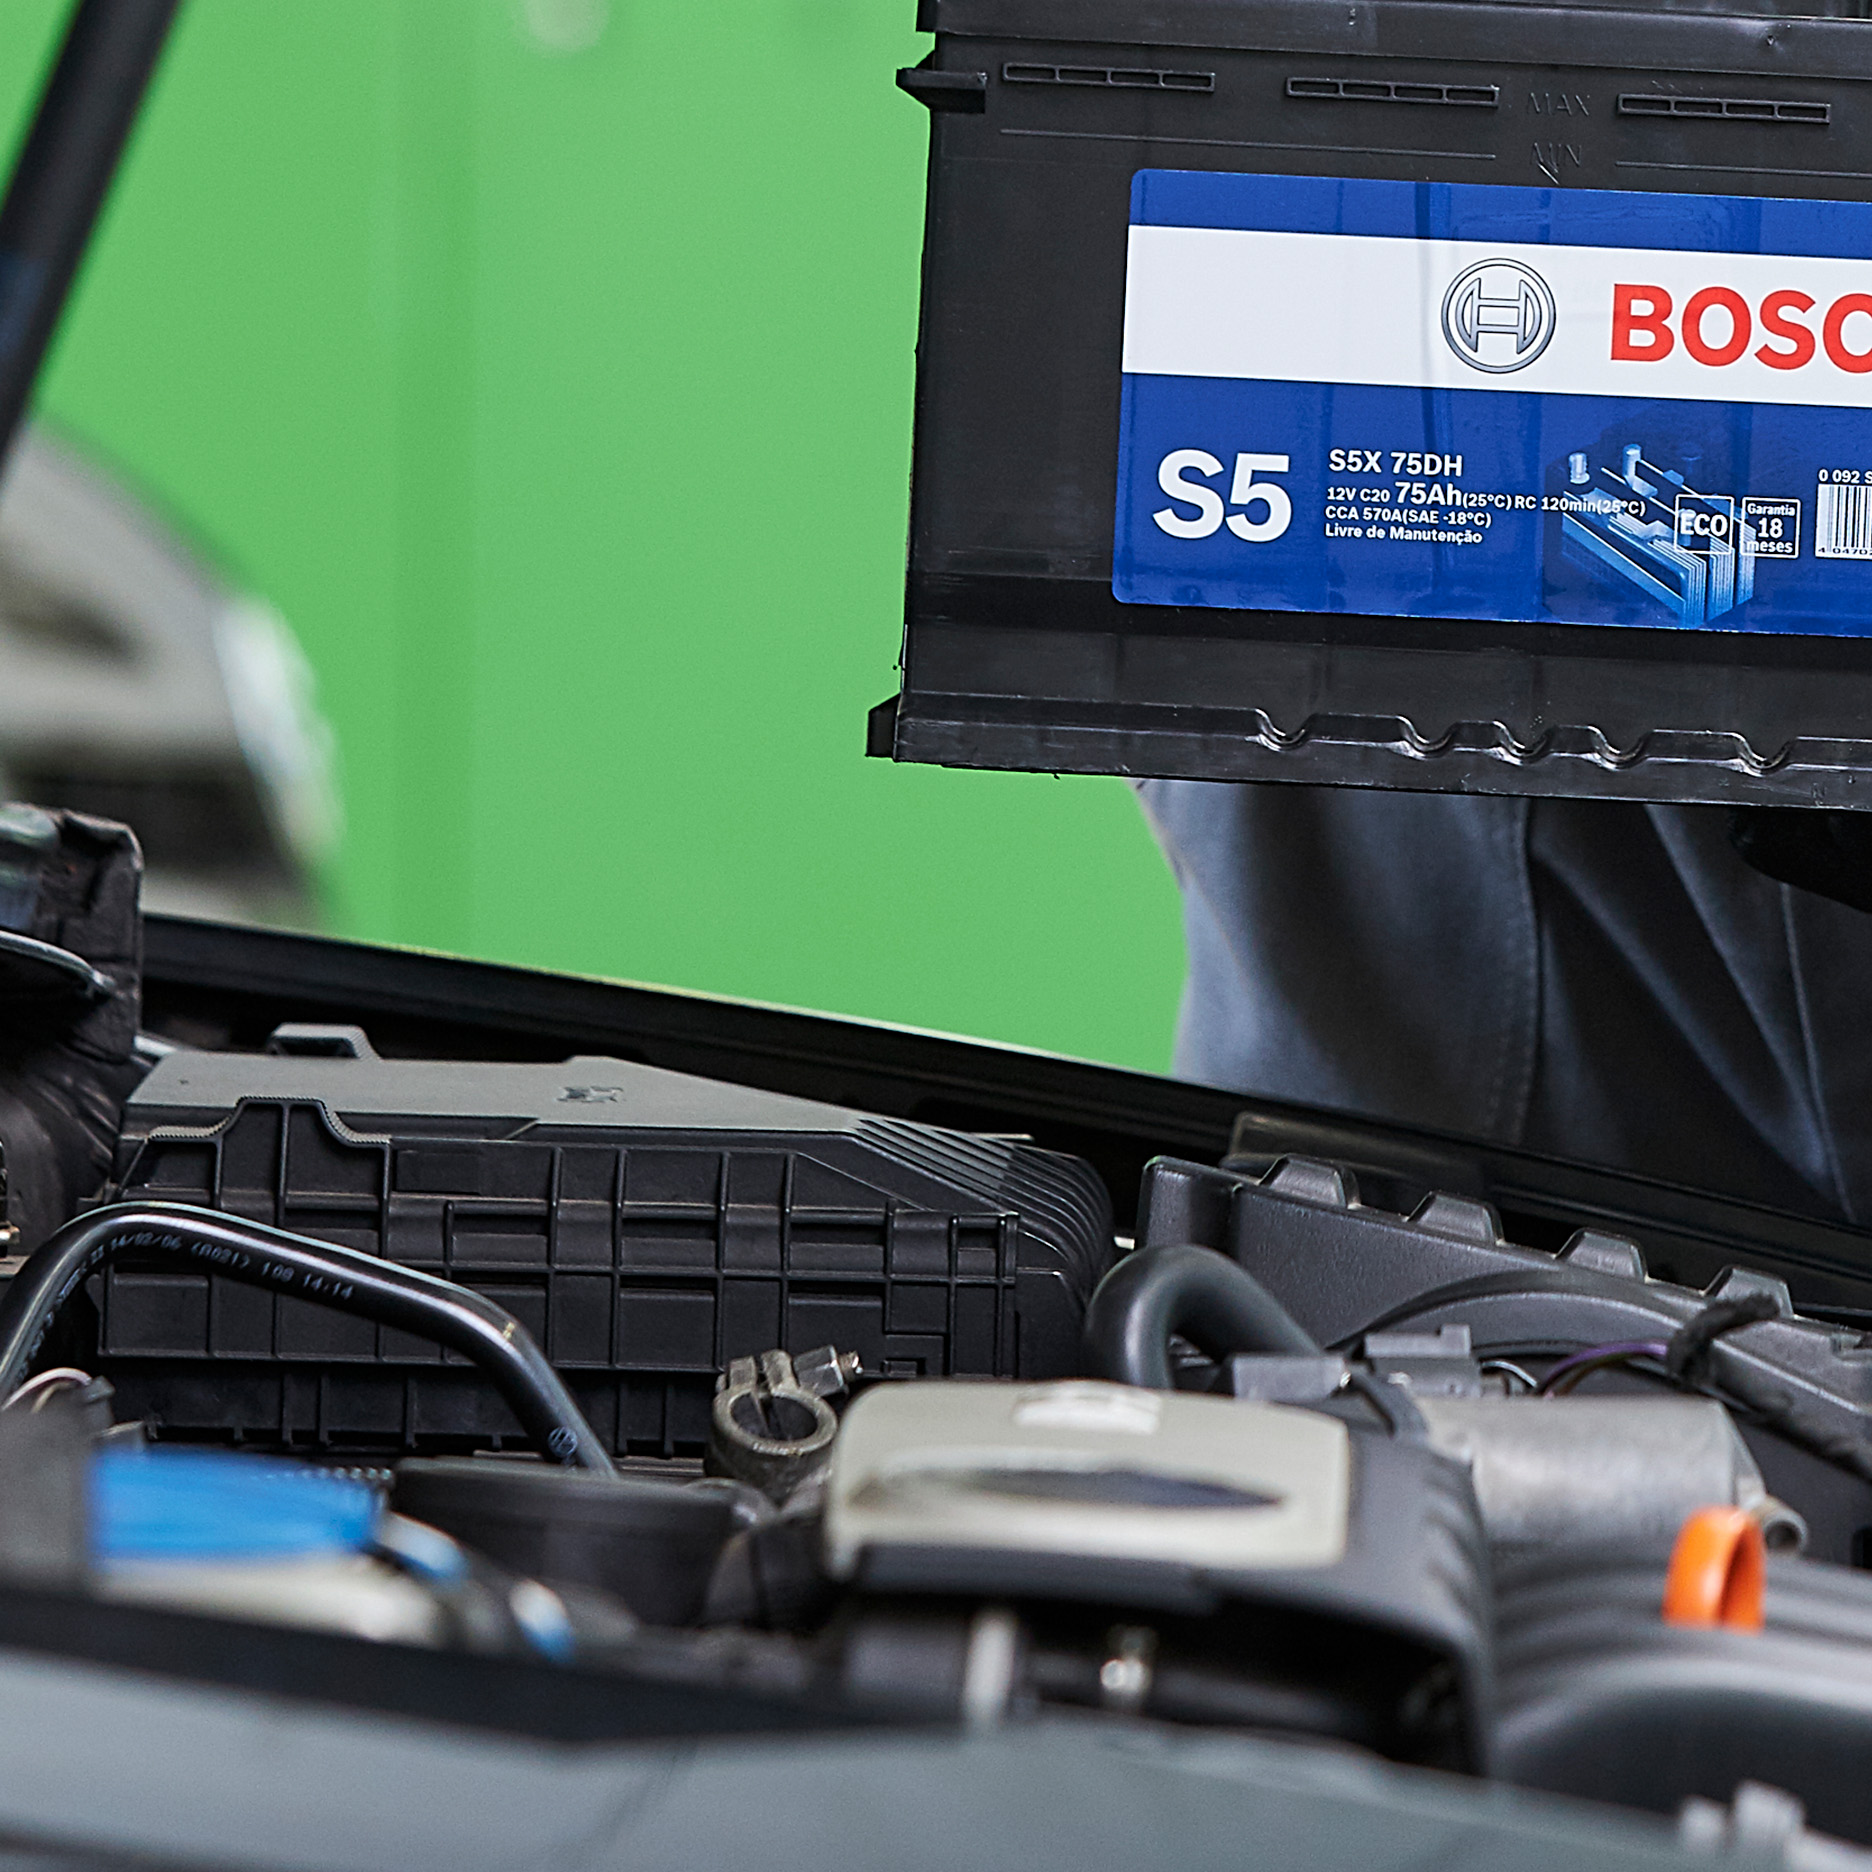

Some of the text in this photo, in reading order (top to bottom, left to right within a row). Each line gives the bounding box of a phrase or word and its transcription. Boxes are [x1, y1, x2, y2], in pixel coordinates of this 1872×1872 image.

[1328, 448, 1463, 477] S5X 75DH
[1818, 469, 1829, 482] 0
[1832, 469, 1861, 484] 092
[1152, 448, 1292, 542] S5
[1327, 487, 1357, 501] 12V
[1360, 488, 1391, 503] C20
[1515, 496, 1537, 510] RC
[1325, 506, 1359, 521] CCA
[1747, 503, 1796, 517] Garantia
[1325, 523, 1483, 545] Livre de Manutenção
[1680, 514, 1728, 537] ECO
[1758, 517, 1784, 539] 18
[1746, 541, 1793, 554] meses
